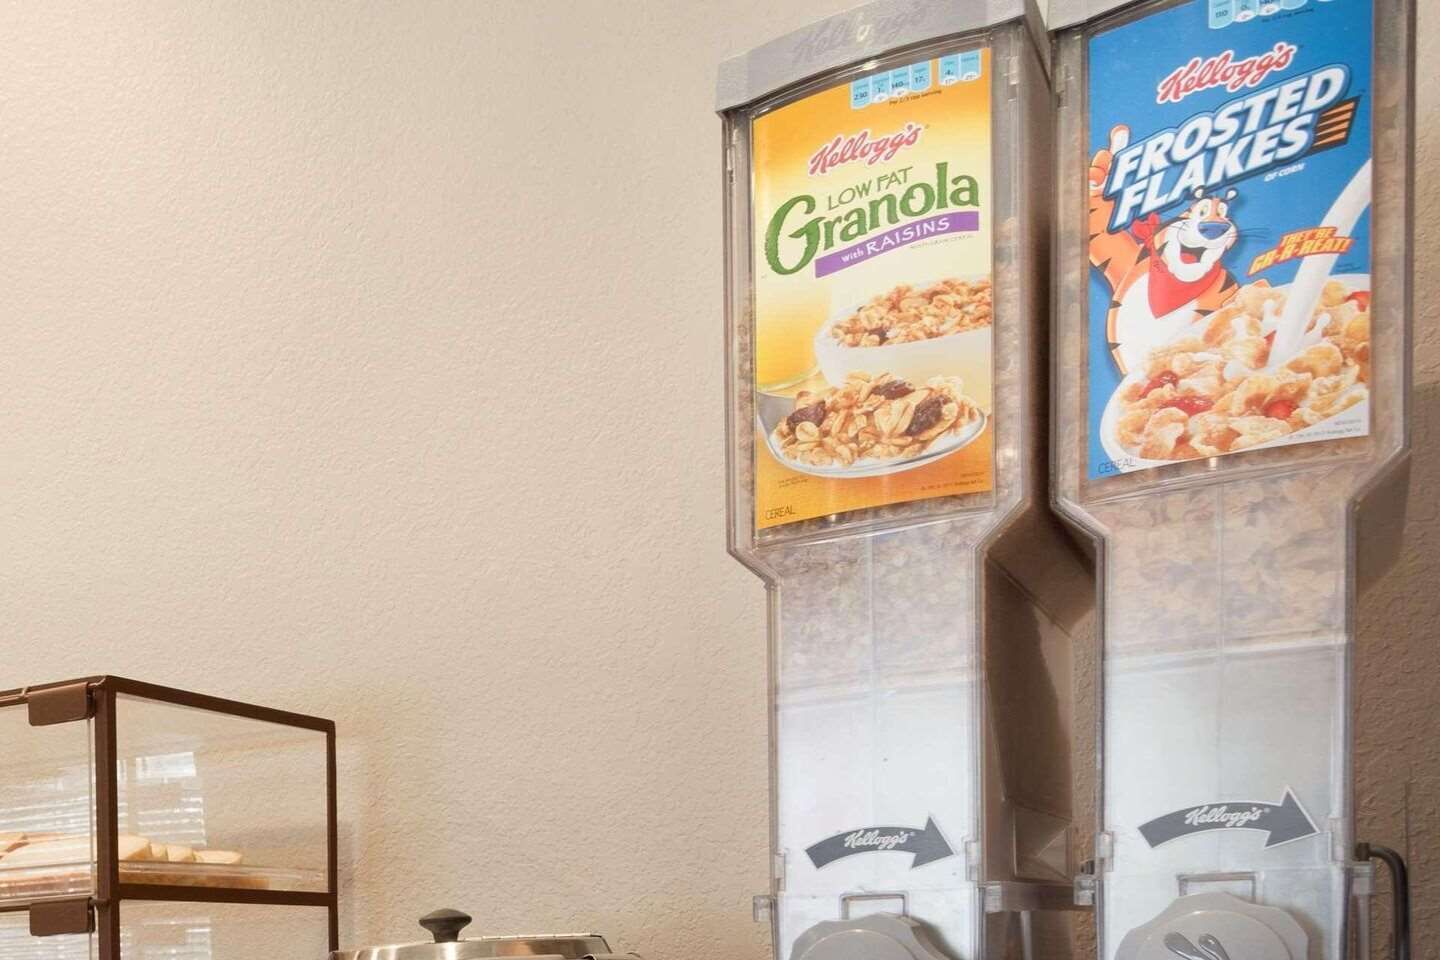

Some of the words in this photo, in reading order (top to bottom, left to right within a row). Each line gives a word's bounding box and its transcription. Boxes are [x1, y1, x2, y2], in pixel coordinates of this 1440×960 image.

[1159, 43, 1297, 103] Kellogg's
[809, 124, 922, 176] Kellogg's
[1109, 67, 1347, 195] FROSTED
[828, 180, 873, 211] LOW
[877, 166, 914, 193] FAT
[1112, 113, 1313, 230] FLAKES
[765, 161, 980, 276] Granola
[840, 247, 865, 262] with
[865, 217, 950, 255] RAISINS
[765, 506, 796, 520] CEREAL
[844, 829, 909, 850] Kellogg's
[1183, 805, 1262, 828] Kellogg's
